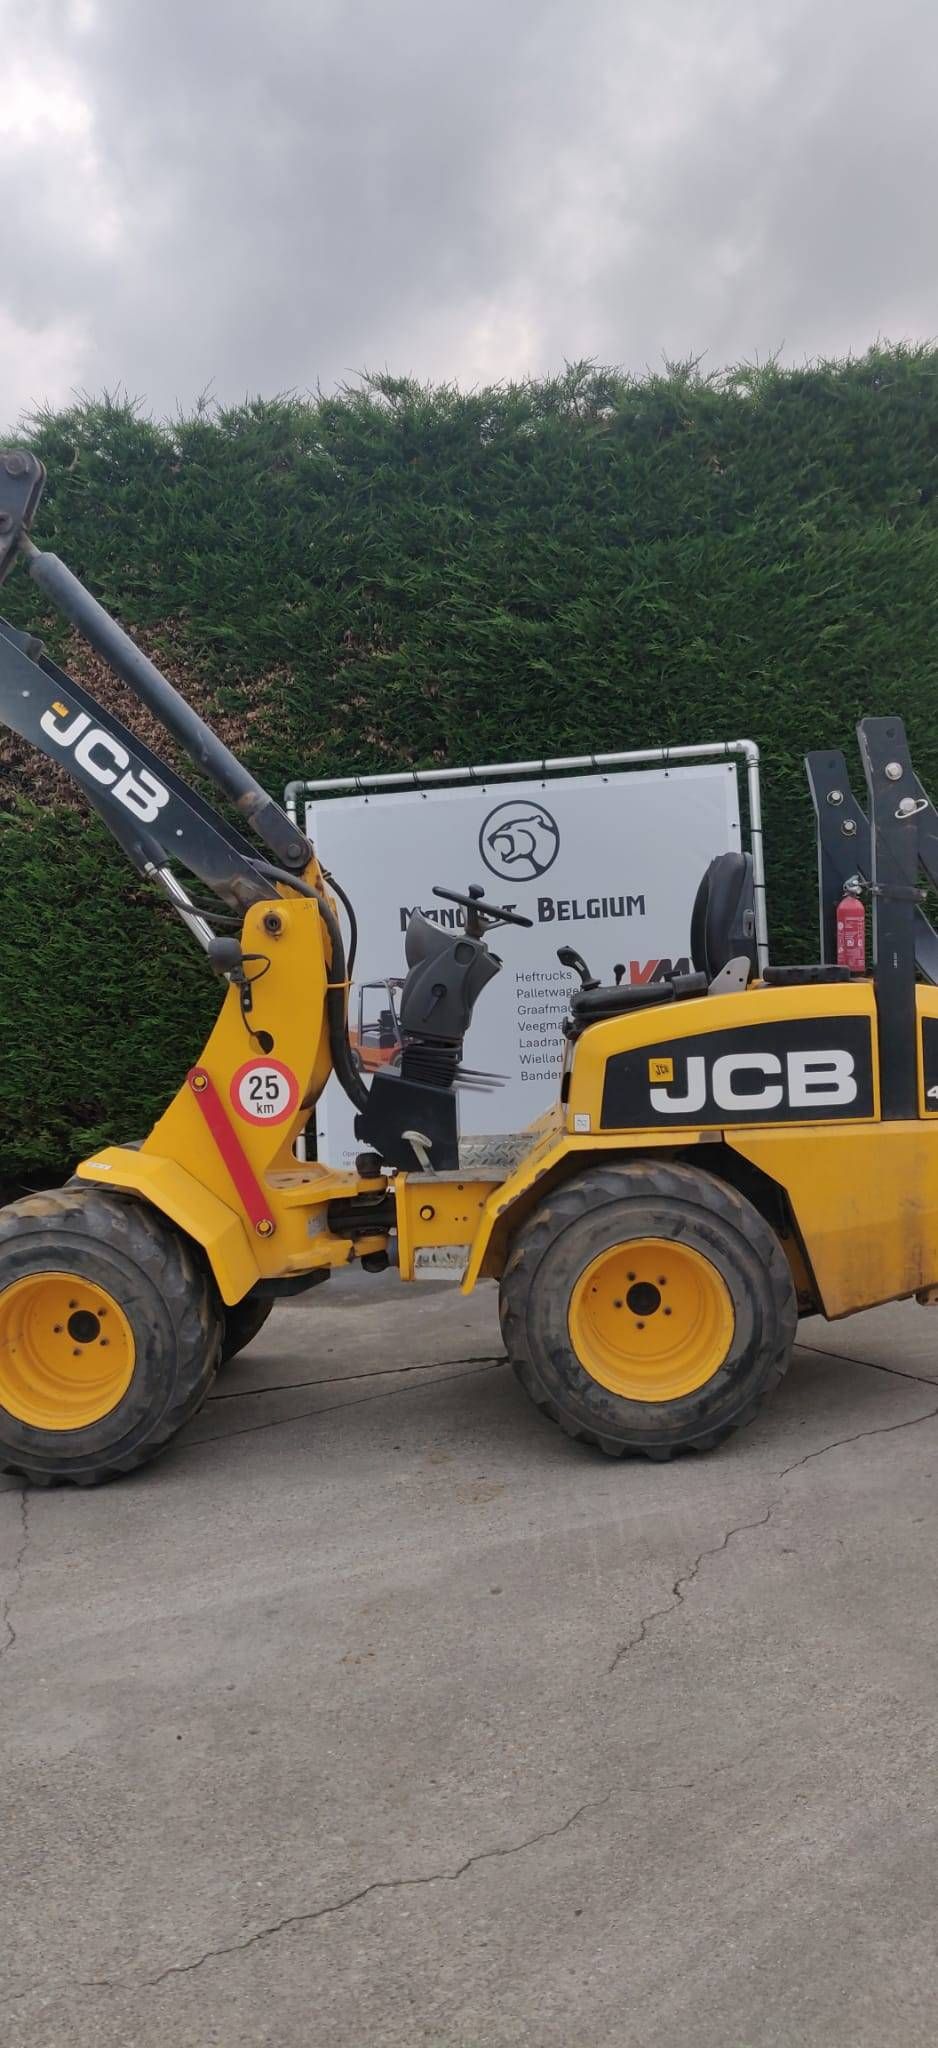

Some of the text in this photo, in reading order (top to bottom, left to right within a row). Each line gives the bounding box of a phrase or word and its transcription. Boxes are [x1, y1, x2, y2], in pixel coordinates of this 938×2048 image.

[40, 702, 169, 823] JCB
[537, 895, 646, 922] BELGIUM
[516, 970, 573, 982] Heftrucks
[249, 1075, 279, 1101] 25
[650, 1050, 857, 1113] JCB
[256, 1102, 274, 1114] km
